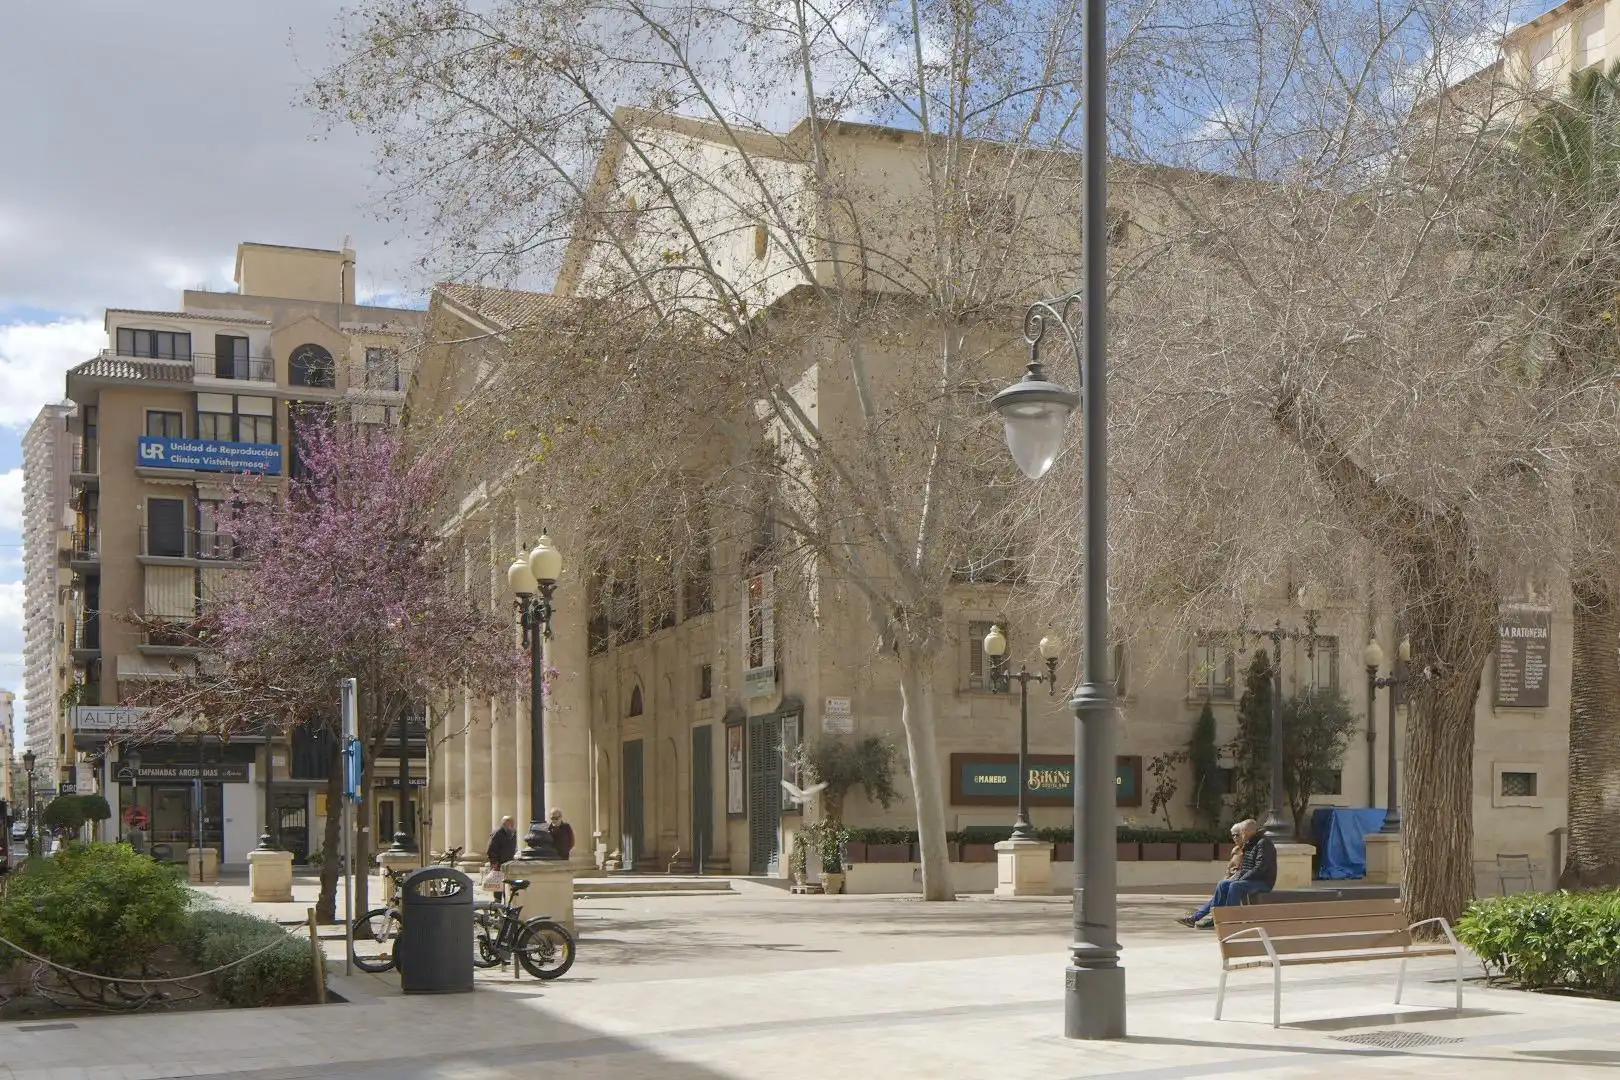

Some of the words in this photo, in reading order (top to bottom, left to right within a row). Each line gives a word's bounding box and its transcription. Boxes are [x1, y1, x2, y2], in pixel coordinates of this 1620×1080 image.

[170, 442, 202, 453] Unidad
[206, 443, 217, 453] de
[219, 445, 279, 457] Reproducción
[1500, 627, 1510, 637] LA
[1511, 627, 1547, 638] RATONERA
[138, 768, 177, 777] EMPANADAS
